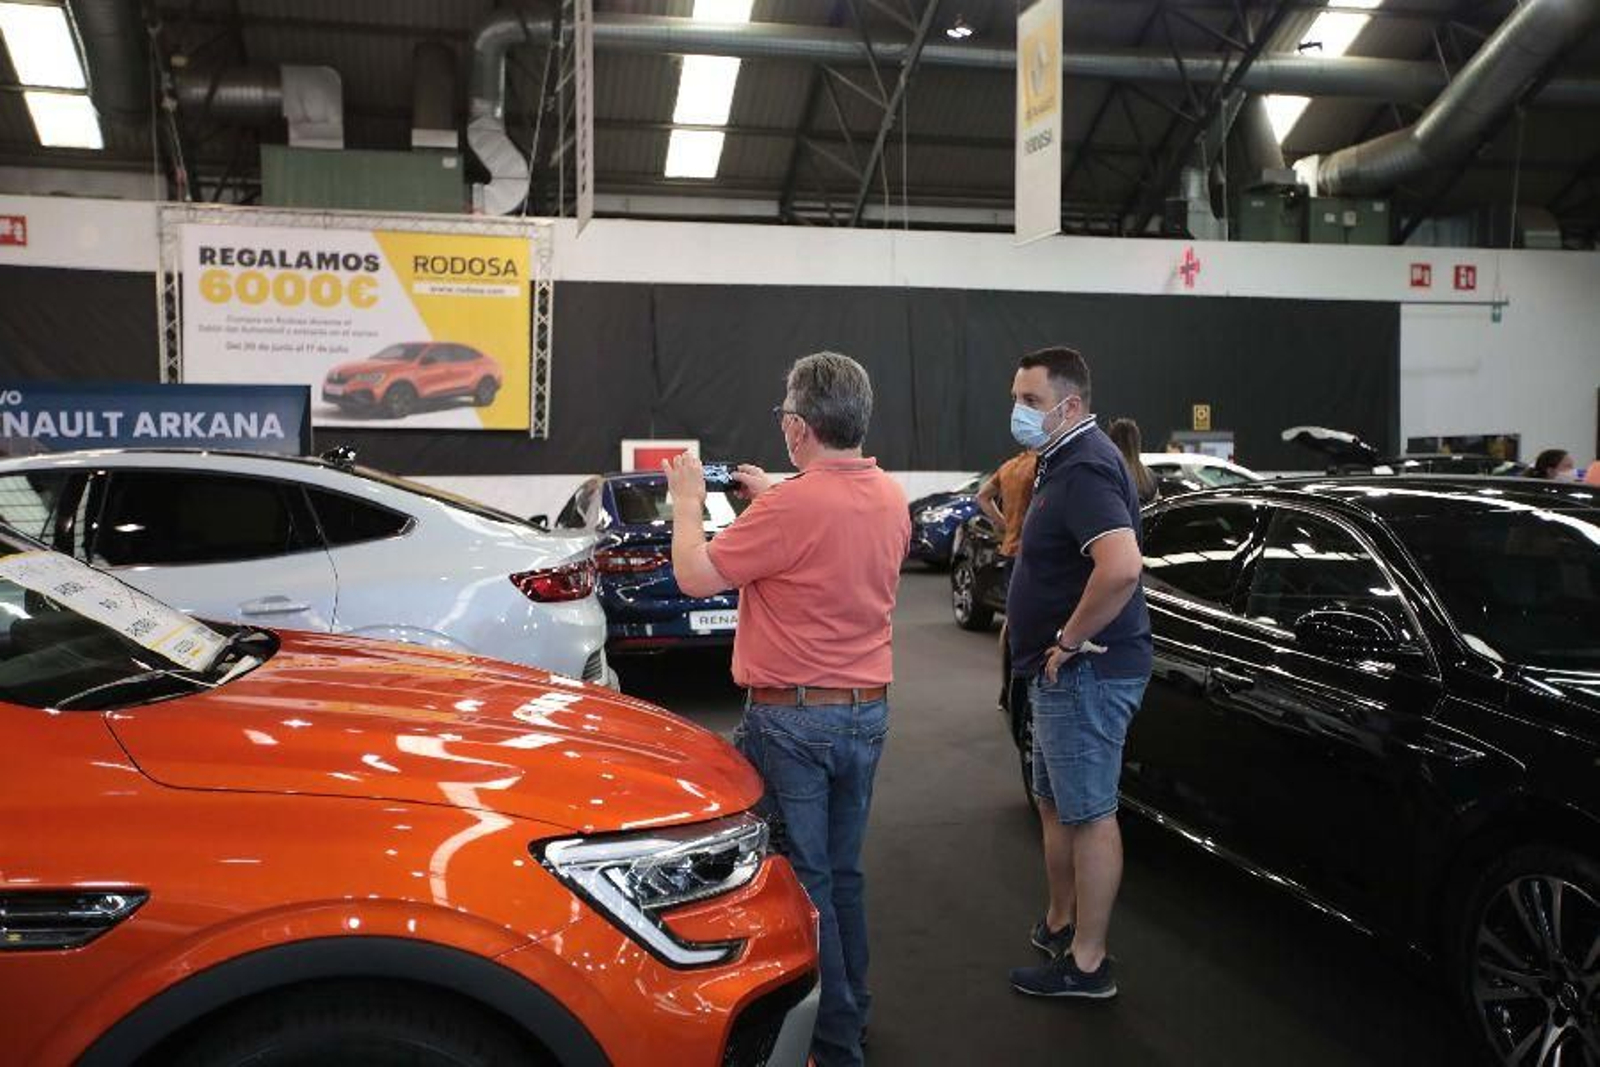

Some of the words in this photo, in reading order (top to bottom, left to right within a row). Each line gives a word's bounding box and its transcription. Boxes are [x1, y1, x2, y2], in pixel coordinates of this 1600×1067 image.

[198, 245, 381, 273] REGALAMOS
[412, 255, 518, 276] RODOSA
[199, 268, 380, 309] 6000€
[0, 411, 124, 438] NAULT
[132, 411, 285, 438] ARKANA
